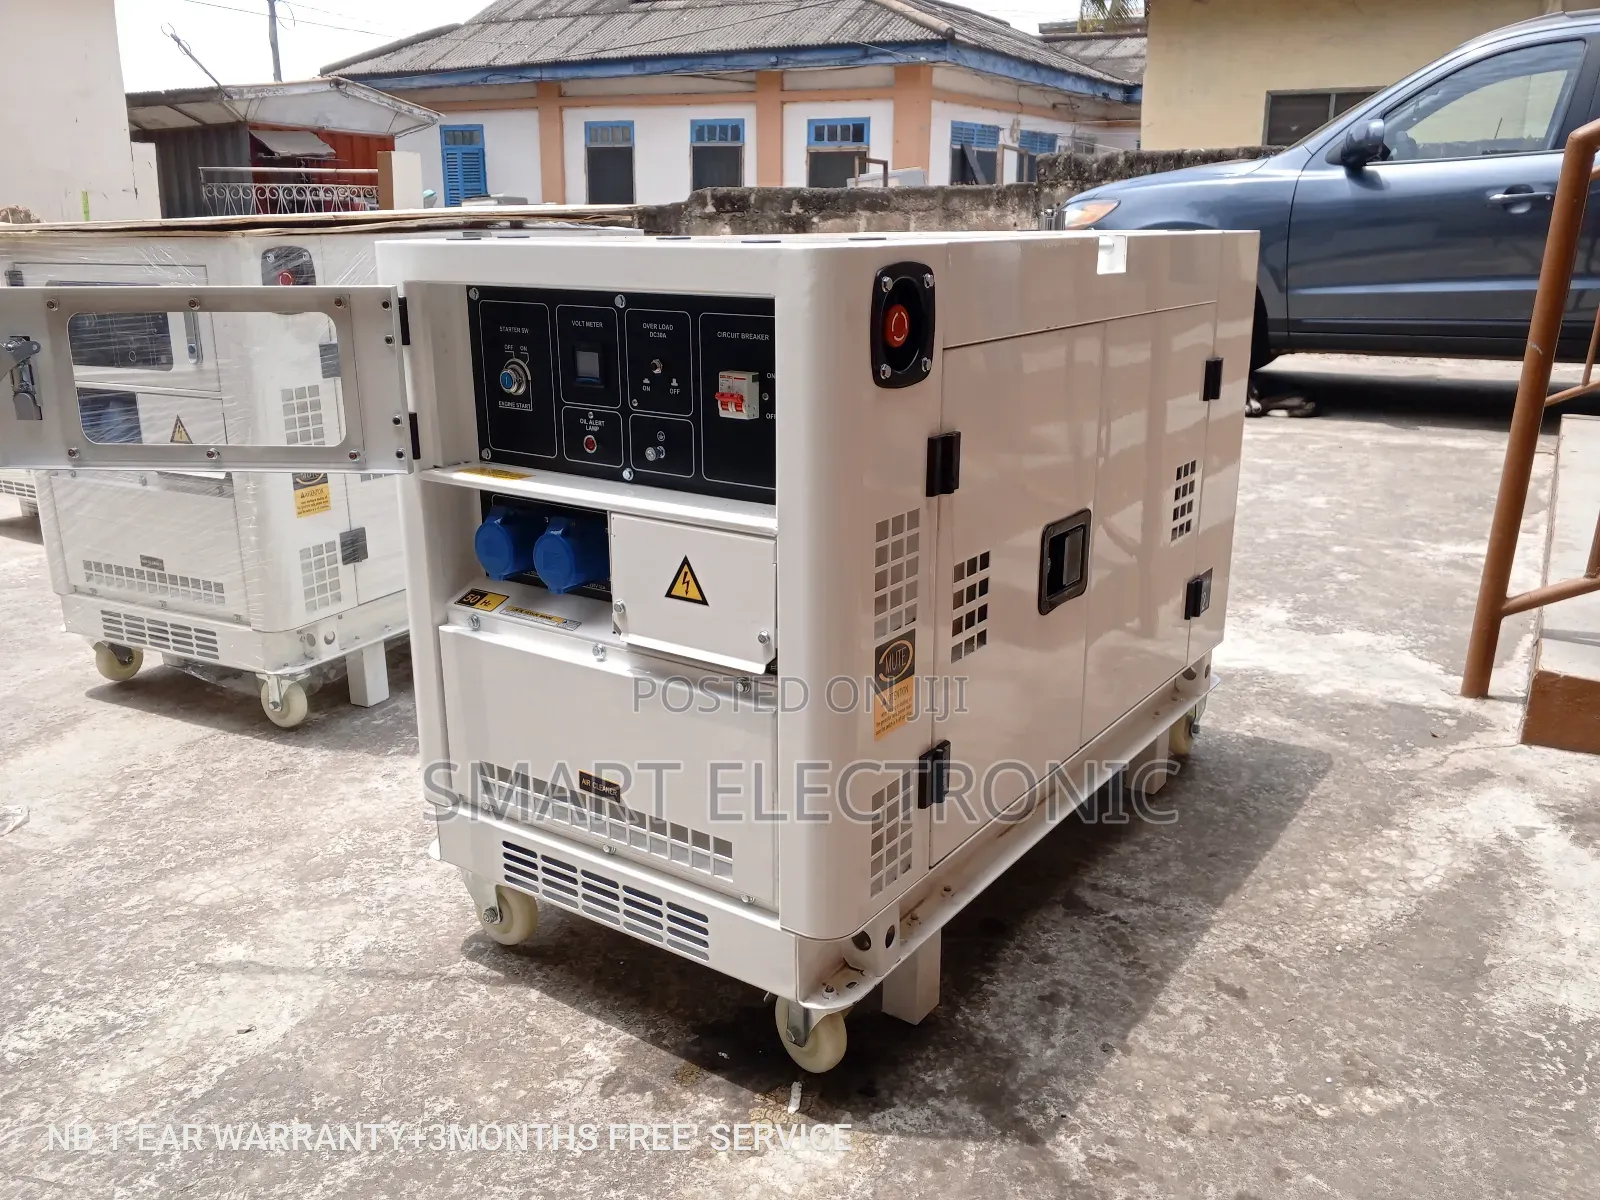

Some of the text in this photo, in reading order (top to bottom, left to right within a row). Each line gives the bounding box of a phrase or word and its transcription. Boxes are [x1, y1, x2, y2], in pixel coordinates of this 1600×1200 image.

[659, 323, 674, 331] LOAD
[717, 331, 769, 340] CIRCUIT BREAKER
[499, 400, 516, 408] ENGINE
[463, 593, 480, 604] 50
[885, 648, 907, 674] MUTE
[582, 778, 617, 796] AIR CLEANER
